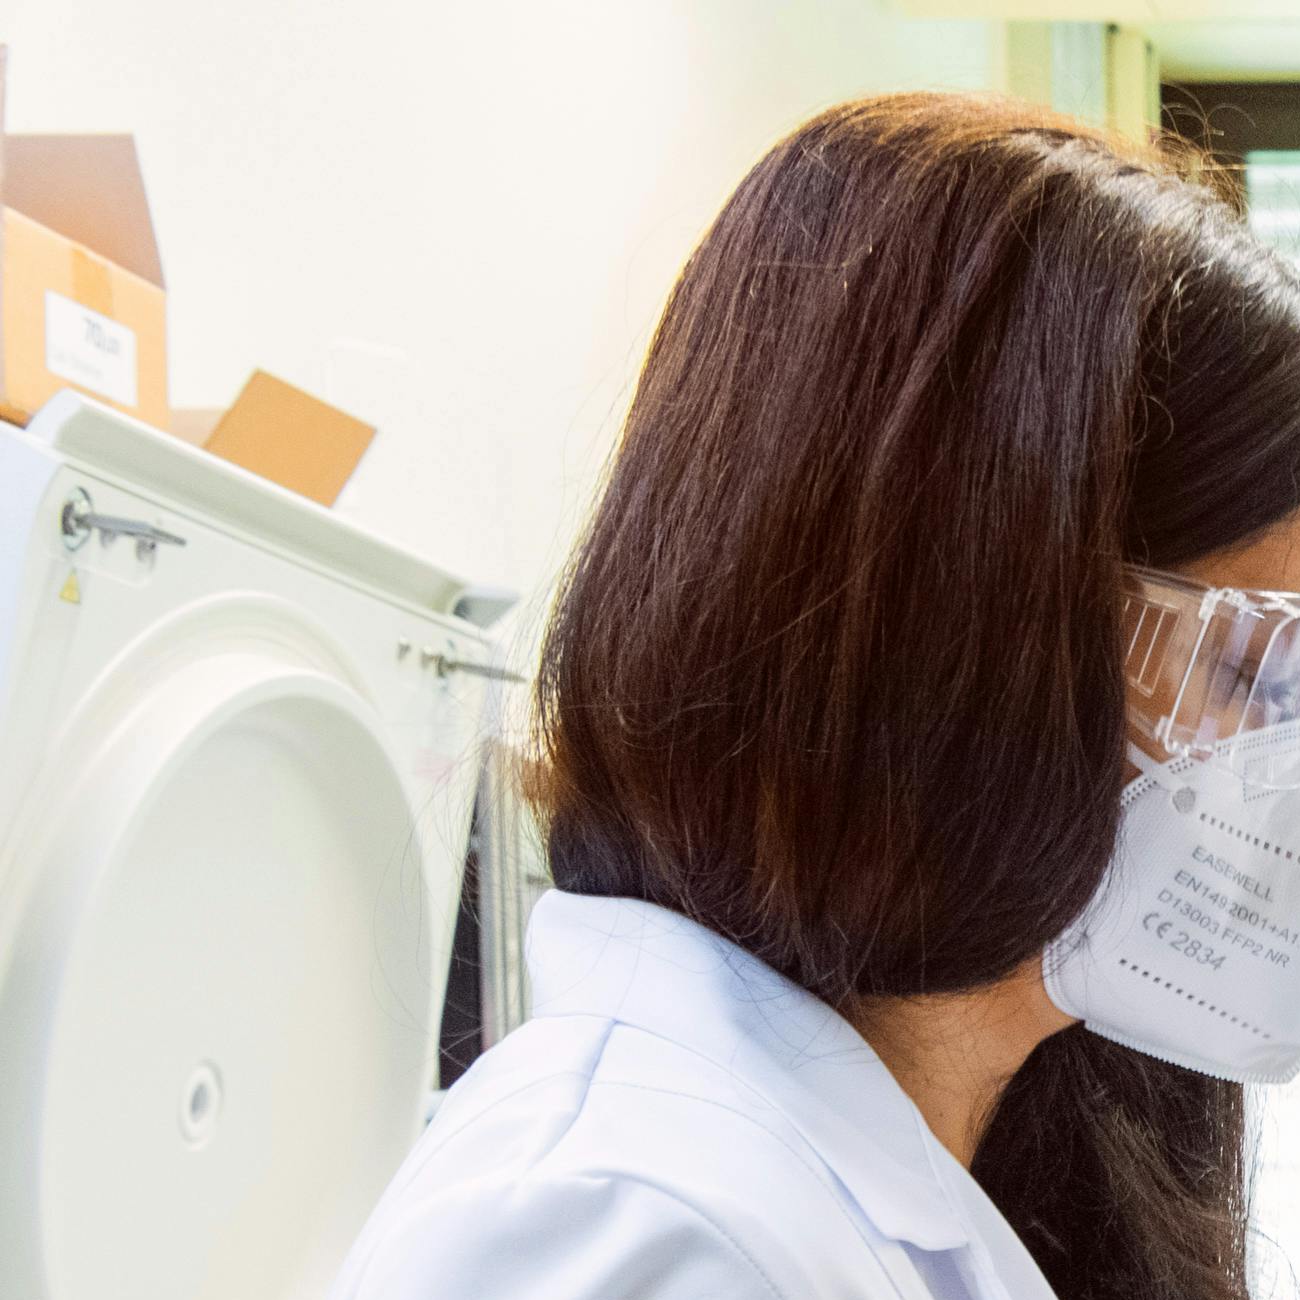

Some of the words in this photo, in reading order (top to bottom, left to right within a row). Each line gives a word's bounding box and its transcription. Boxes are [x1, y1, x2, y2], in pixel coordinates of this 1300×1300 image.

[1191, 844, 1274, 904] EASEWELL
[1168, 931, 1228, 971] 2834
[1220, 926, 1264, 957] FFP2
[1264, 947, 1291, 969] NR
